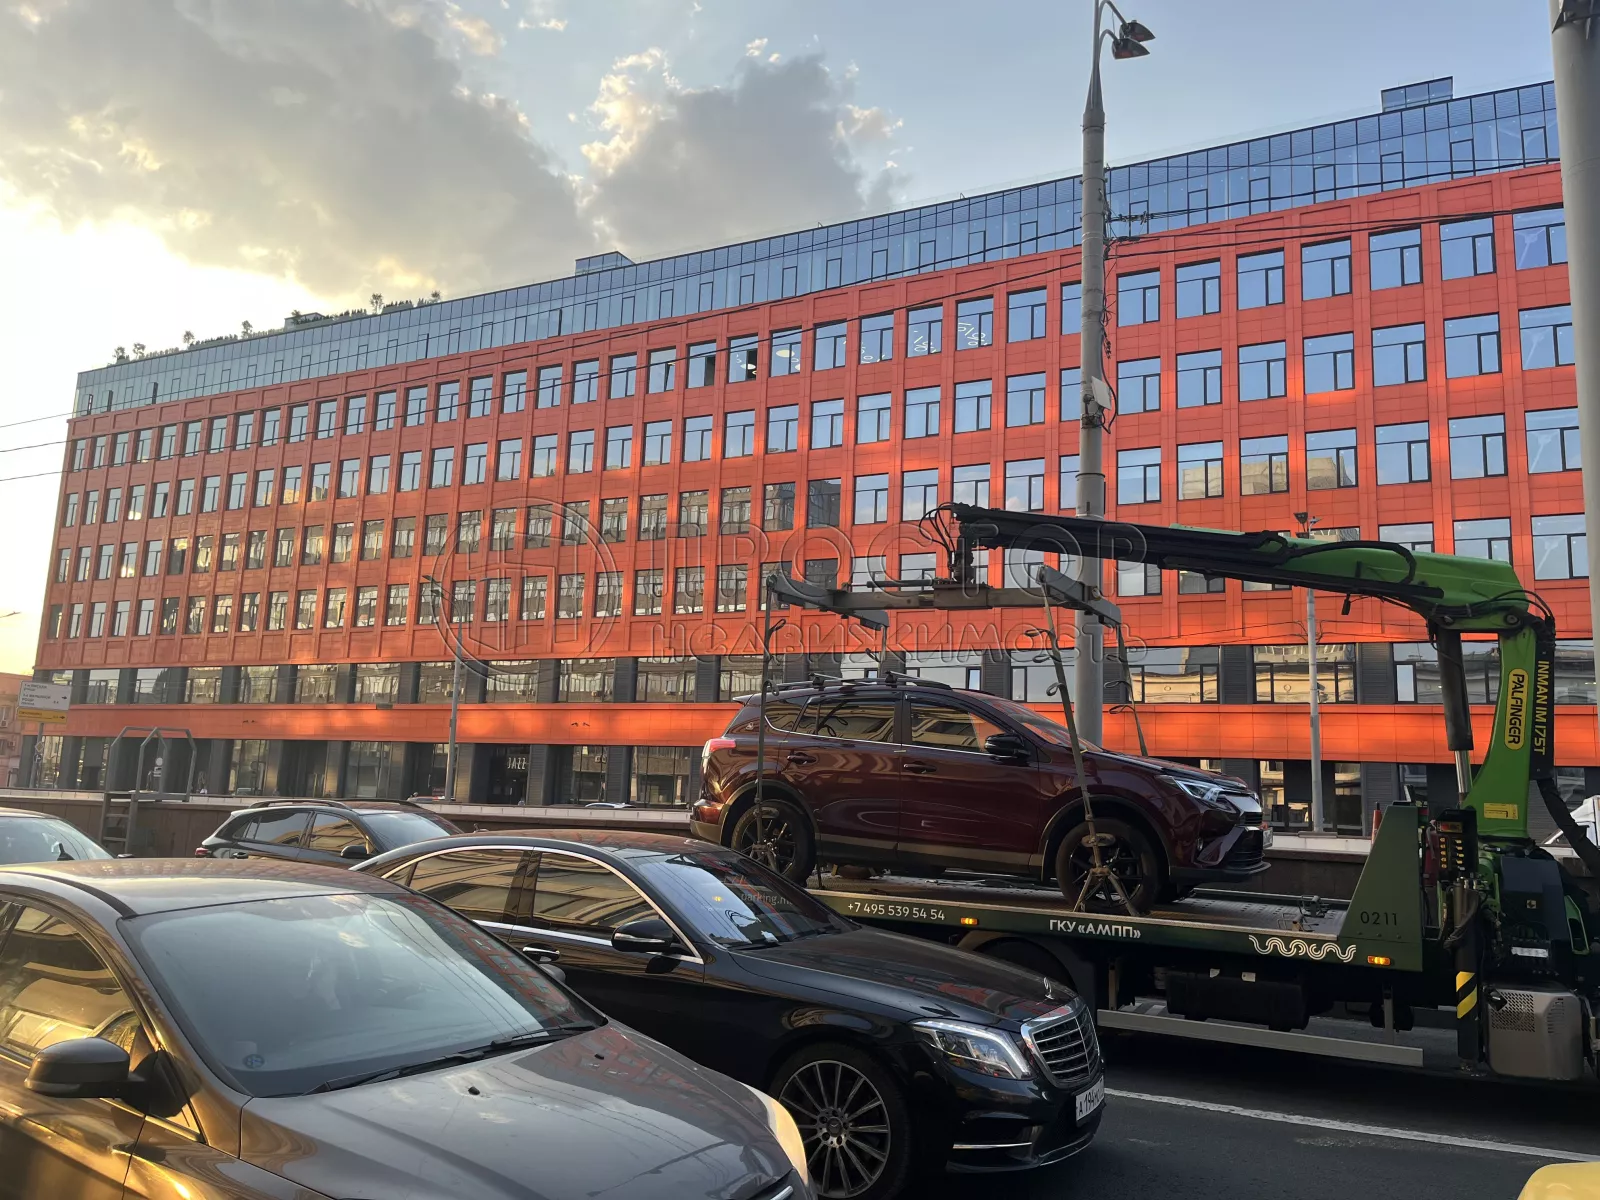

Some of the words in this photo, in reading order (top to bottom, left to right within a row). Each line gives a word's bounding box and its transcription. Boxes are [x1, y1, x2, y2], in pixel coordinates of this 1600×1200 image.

[1535, 660, 1549, 704] INMAN
[1508, 673, 1524, 744] PALFINGER
[1535, 708, 1547, 722] IM
[508, 757, 526, 770] JAZZ
[848, 902, 861, 913] +7
[863, 903, 885, 915] 495
[888, 905, 910, 917] 539
[912, 907, 927, 919] 54
[930, 909, 945, 921] 54
[1360, 911, 1397, 926] 0211
[1049, 919, 1076, 932] ГКУ
[1077, 923, 1141, 939] «АМПП»
